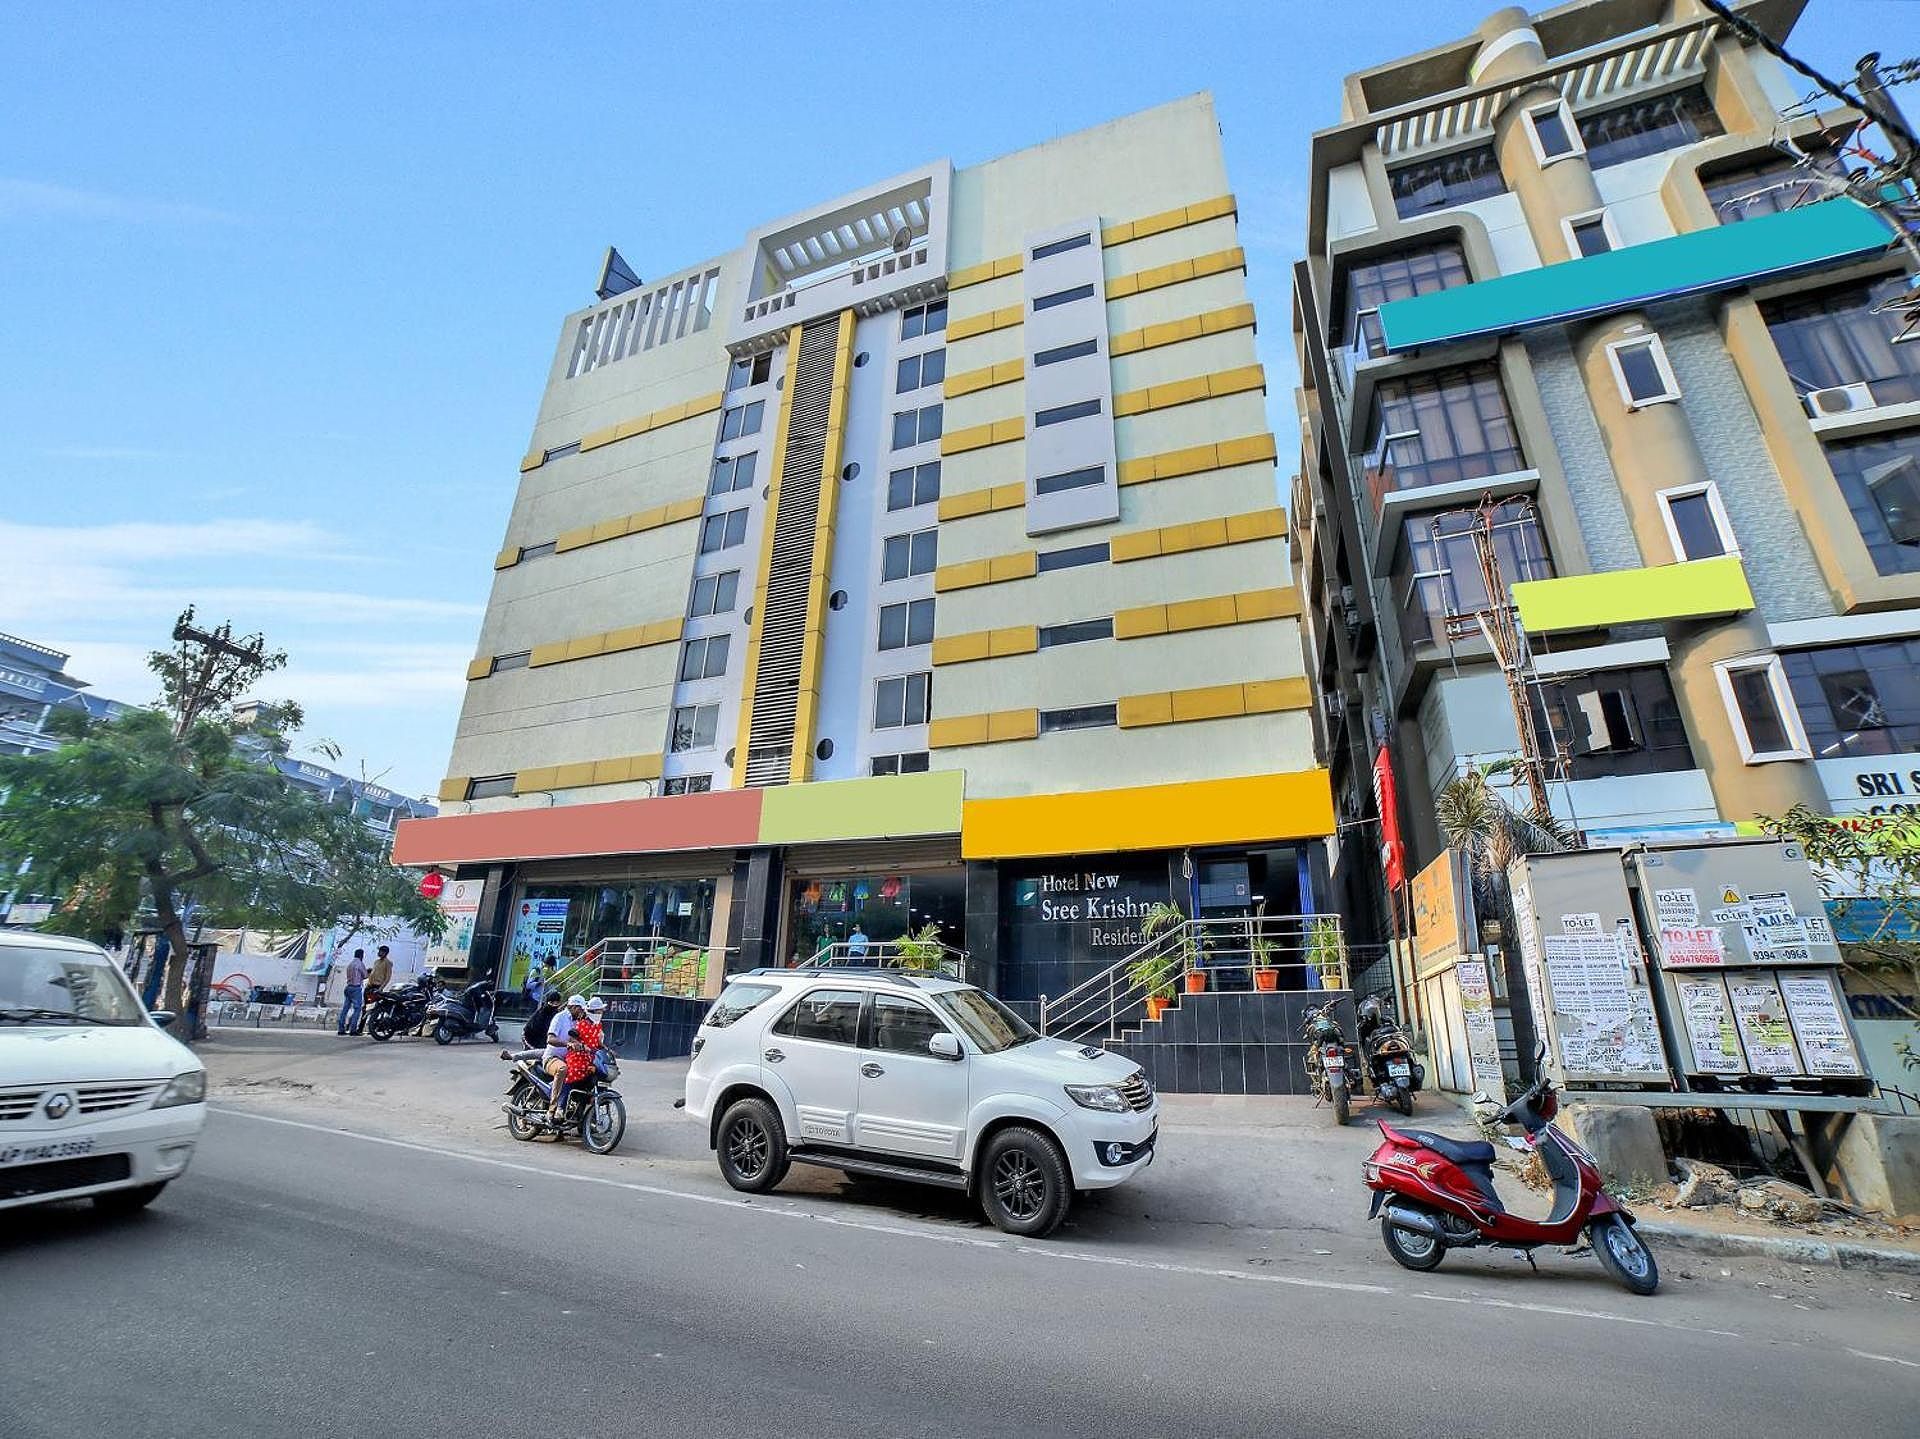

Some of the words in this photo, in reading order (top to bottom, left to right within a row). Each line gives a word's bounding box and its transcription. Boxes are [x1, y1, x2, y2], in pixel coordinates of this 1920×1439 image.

[1856, 772, 1904, 796] SRI
[1041, 873, 1079, 892] Hotel
[1084, 872, 1120, 891] New
[1657, 894, 1691, 902] TO-LET
[1042, 899, 1080, 921] Sree
[1086, 896, 1160, 919] Krishn
[1563, 919, 1594, 928] TO-LET
[1091, 926, 1163, 950] Resideny
[1662, 930, 1713, 943] TO-LET
[815, 1127, 841, 1137] TOYOTA
[1391, 1151, 1417, 1165] Duro
